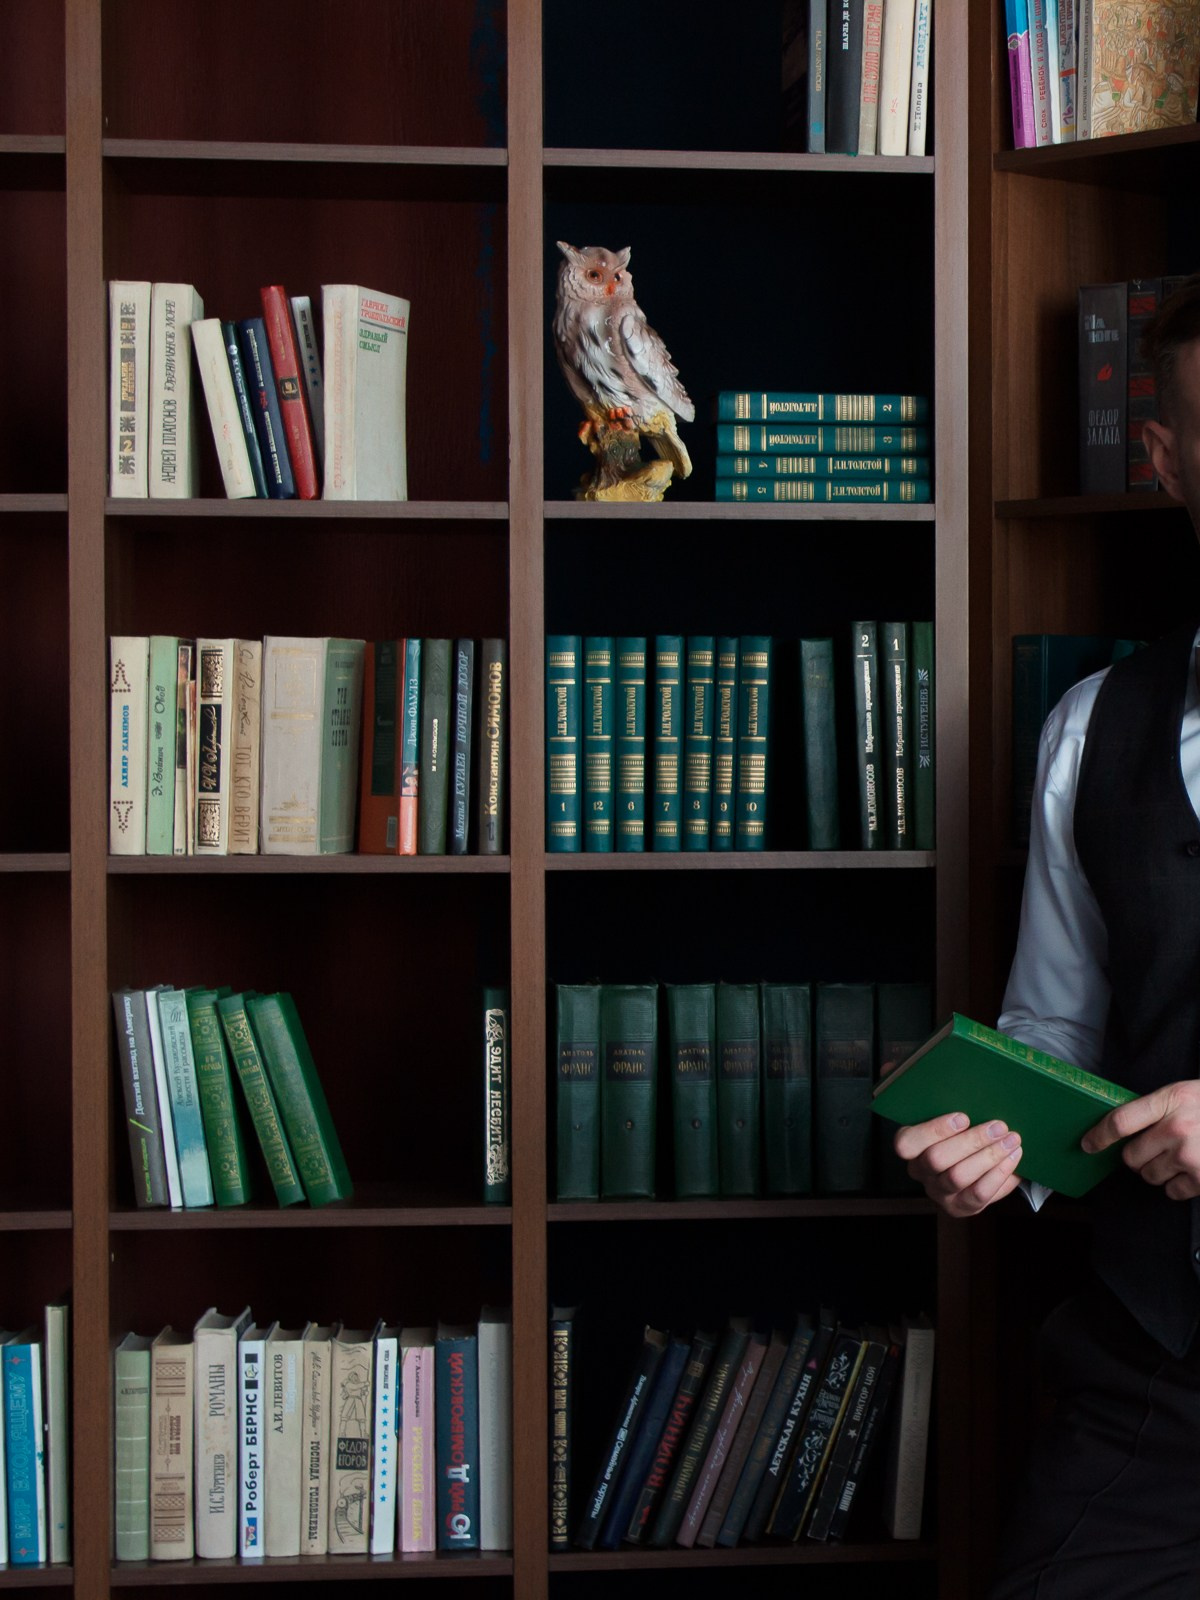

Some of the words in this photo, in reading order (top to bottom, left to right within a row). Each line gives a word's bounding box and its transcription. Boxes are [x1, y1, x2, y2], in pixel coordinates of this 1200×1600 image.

[842, 11, 850, 21] ДЕ
[867, 4, 881, 24] РАЯ
[866, 25, 880, 47] ТЕБЕ
[917, 3, 928, 68] МОЦАРТ
[864, 52, 878, 80] СУЛЮ
[863, 96, 875, 104] Я
[864, 83, 877, 95] НЕ
[914, 82, 923, 120] Попова
[164, 299, 176, 328] МОРЕ
[361, 298, 389, 313] ГАВРИИЛ
[361, 309, 406, 329] ТРОЕПОЛЬСКИЙ
[359, 328, 388, 343] ЗДРАВЫЙ
[359, 340, 381, 353] СМЫСЛ
[163, 330, 177, 393] ЮВЕНИЛЬНОЕ
[121, 361, 129, 401] ПРЕДАНИЯ
[162, 399, 177, 446] ПЛАТОНОВ
[769, 402, 817, 414] Л.Н.ТОЛСТОЙ
[1089, 409, 1119, 426] ФЕДОР
[123, 440, 133, 452] 2
[769, 434, 817, 446] Л.Н.ТОЛСТОЙ
[1087, 426, 1120, 446] ЗАЛАТА
[160, 449, 177, 484] АНДРЕЙ
[834, 459, 882, 471] Л.Н.ТОЛСТОЙ
[832, 484, 881, 496] Л.Н.ТОЛСТОЙ
[862, 635, 869, 646] 2
[893, 639, 899, 651] 1
[458, 650, 469, 690] ДОЗОР
[155, 684, 165, 714] Овод
[337, 687, 348, 705] ТРИ
[408, 678, 419, 717] ФАУЛЗ
[485, 662, 502, 739] СИМОНОВ
[557, 687, 568, 735] Л.Н.ТОЛСТОЙ
[592, 685, 603, 735] Л.Н.ТОЛСТОЙ
[626, 686, 636, 735] Л.Н.ТОЛСТОЙ
[661, 686, 671, 735] Л.Н.ТОЛСТОЙ
[694, 686, 704, 735] Л.Н.ТОЛСТОЙ
[720, 687, 731, 736] Л.Н.ТОЛСТОЙ
[748, 687, 758, 735] Л.Н.ТОЛСТОЙ
[121, 705, 129, 751] ХАКИМОВ
[331, 708, 352, 726] СТРАНЫ
[407, 719, 418, 747] Джон
[456, 692, 468, 743] НОЧНОЙ
[331, 729, 348, 746] СВЕТА
[121, 755, 129, 788] АХИЯР
[152, 746, 164, 783] Войнич
[456, 752, 467, 796] КУРАЕВ
[484, 741, 500, 816] Константин
[234, 776, 251, 798] КТО
[455, 801, 466, 839] Михаил
[560, 802, 565, 811] 1
[592, 801, 604, 810] 12
[628, 801, 634, 810] 6
[664, 802, 670, 811] 7
[693, 801, 700, 810] 8
[721, 802, 727, 811] 9
[746, 801, 757, 811] 10
[233, 805, 250, 845] ВЕРИТ
[123, 996, 135, 1036] Америку
[128, 1036, 136, 1048] на
[178, 1030, 191, 1066] рассказы
[131, 1048, 142, 1080] взгляд
[491, 1046, 501, 1083] ЭДИТ
[561, 1062, 594, 1075] ФРАНС
[613, 1060, 646, 1074] ФРАНС
[134, 1081, 145, 1116] Долгий
[174, 1075, 185, 1106] Алексей
[184, 1075, 194, 1107] Повести
[491, 1089, 502, 1144] НЕСБИТ
[208, 1364, 226, 1417] РОМАНЫ
[274, 1354, 283, 1409] ЛЕВИТОВ
[853, 1389, 870, 1422] ВИКТОР
[864, 1366, 876, 1388] ЦОЙ
[10, 1372, 31, 1491] ВХОДЯЩЕМУ
[245, 1393, 258, 1446] БЕРНС
[446, 1352, 470, 1484] ДОМБРОВСКИЙ
[768, 1416, 797, 1477] ДЕТСКАЯ
[788, 1373, 813, 1420] КУХНЯ
[310, 1440, 320, 1480] ГОСПОДА
[338, 1455, 367, 1468] ЕГОРОВ
[412, 1426, 424, 1493] РУССКИЙ
[245, 1452, 260, 1511] Роберт
[838, 1480, 856, 1512] СТАЛИН
[15, 1497, 31, 1539] МИР
[309, 1486, 319, 1540] ГОЛОВЛЕВЫ
[412, 1498, 423, 1541] ЯЗЫК
